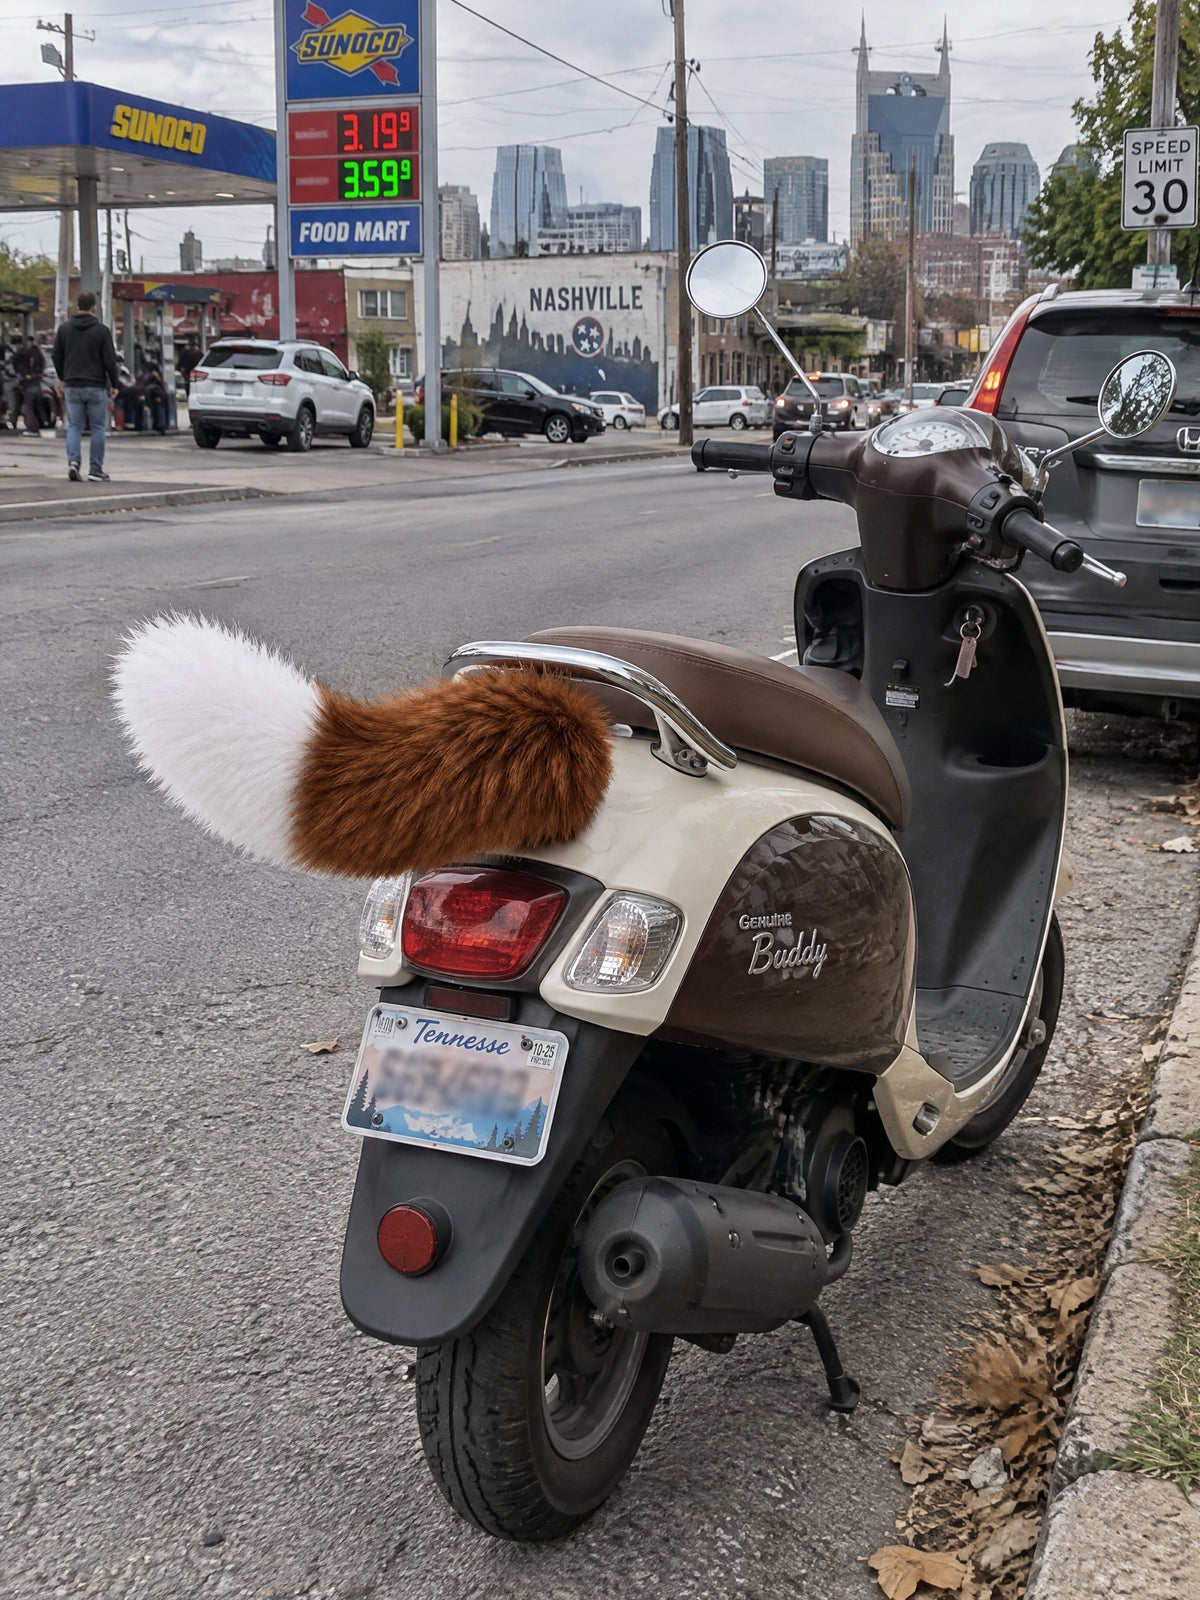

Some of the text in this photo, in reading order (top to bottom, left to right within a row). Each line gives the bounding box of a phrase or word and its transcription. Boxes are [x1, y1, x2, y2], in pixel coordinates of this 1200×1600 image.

[302, 31, 401, 57] SUNOCO
[110, 104, 207, 155] SUNOCO
[1131, 139, 1191, 155] SPEED
[1138, 158, 1184, 174] LIMIT
[1131, 178, 1189, 215] 30
[299, 220, 411, 243] FOOD MART
[529, 285, 643, 312] NASHVILLE
[747, 928, 828, 979] Buddy
